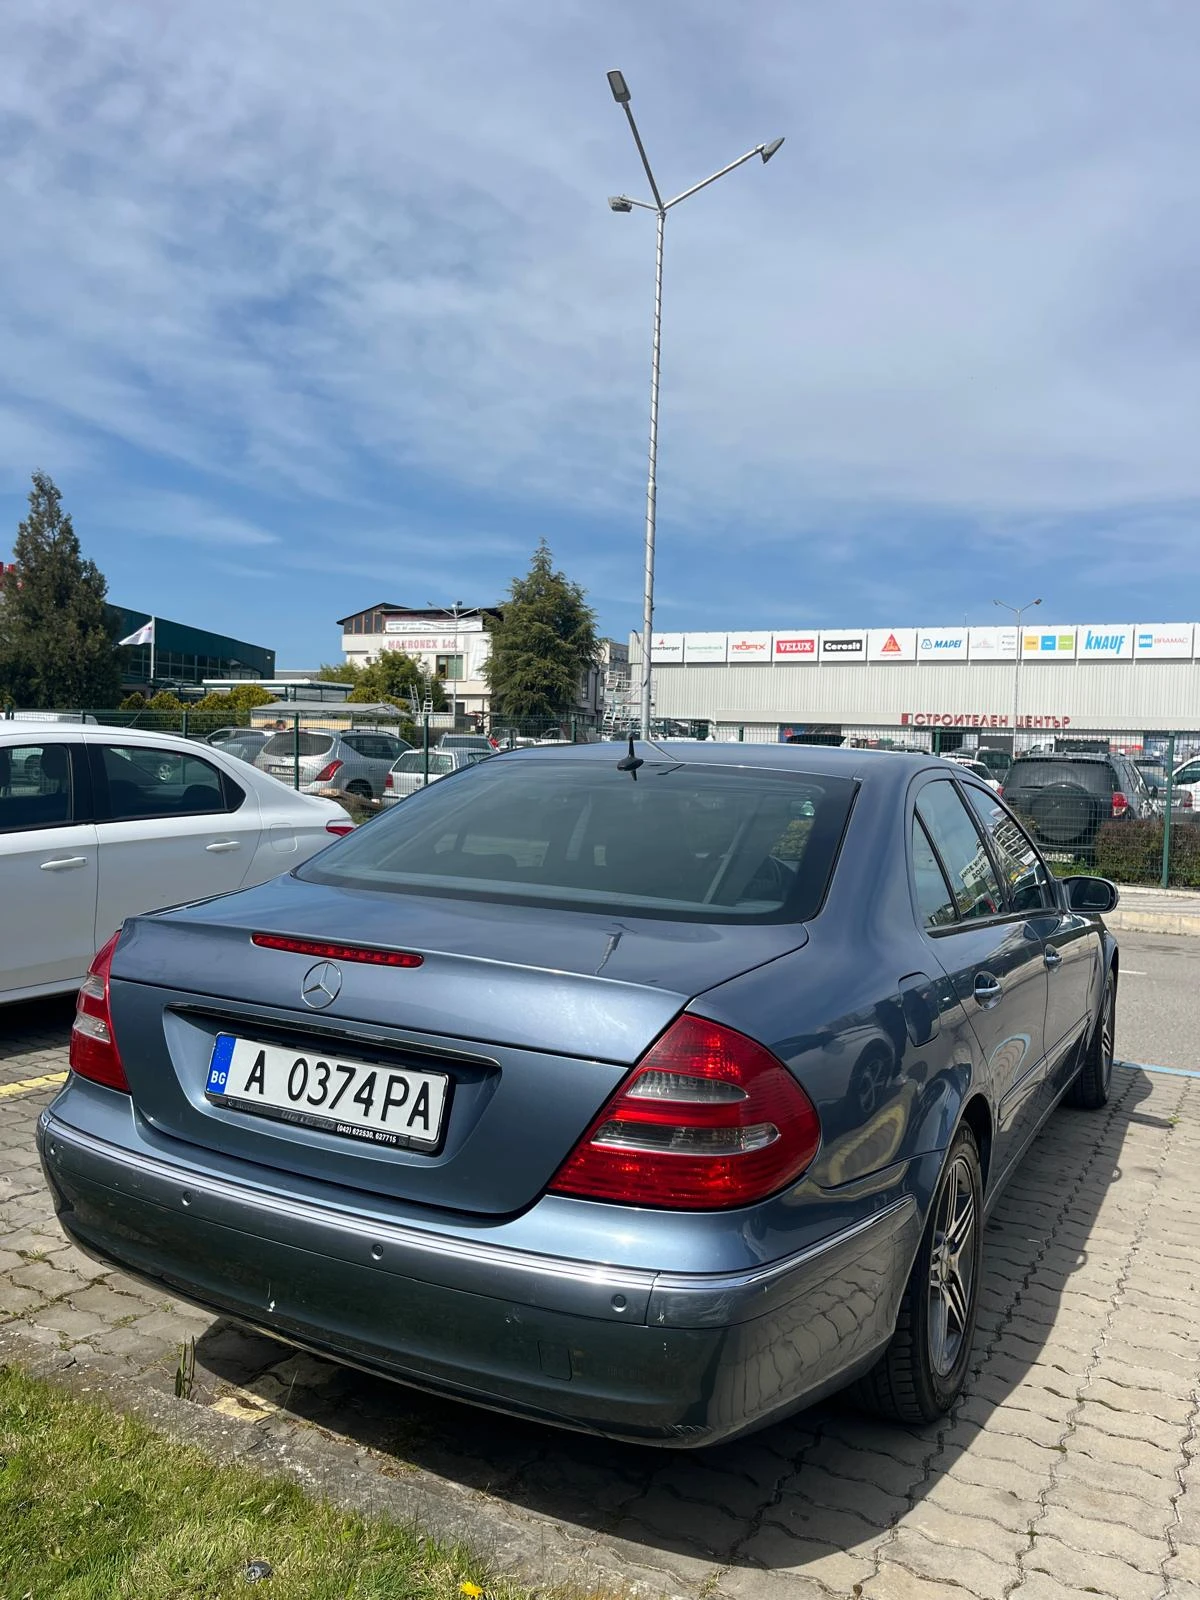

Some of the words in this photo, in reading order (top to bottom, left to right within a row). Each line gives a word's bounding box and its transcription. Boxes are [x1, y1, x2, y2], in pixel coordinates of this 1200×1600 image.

[387, 639, 438, 650] MAKRONEX
[779, 642, 812, 651] VELUX
[824, 642, 861, 651] Ceresit
[934, 640, 962, 649] MAPEI
[1085, 630, 1126, 654] KNAUF
[914, 713, 1009, 727] СТРОИТЕЛЕН
[1015, 715, 1071, 729] ЦЕНТЪР
[210, 1070, 227, 1086] BG
[244, 1050, 266, 1095] A
[336, 1123, 351, 1136] (042)
[375, 1131, 397, 1144] 627715
